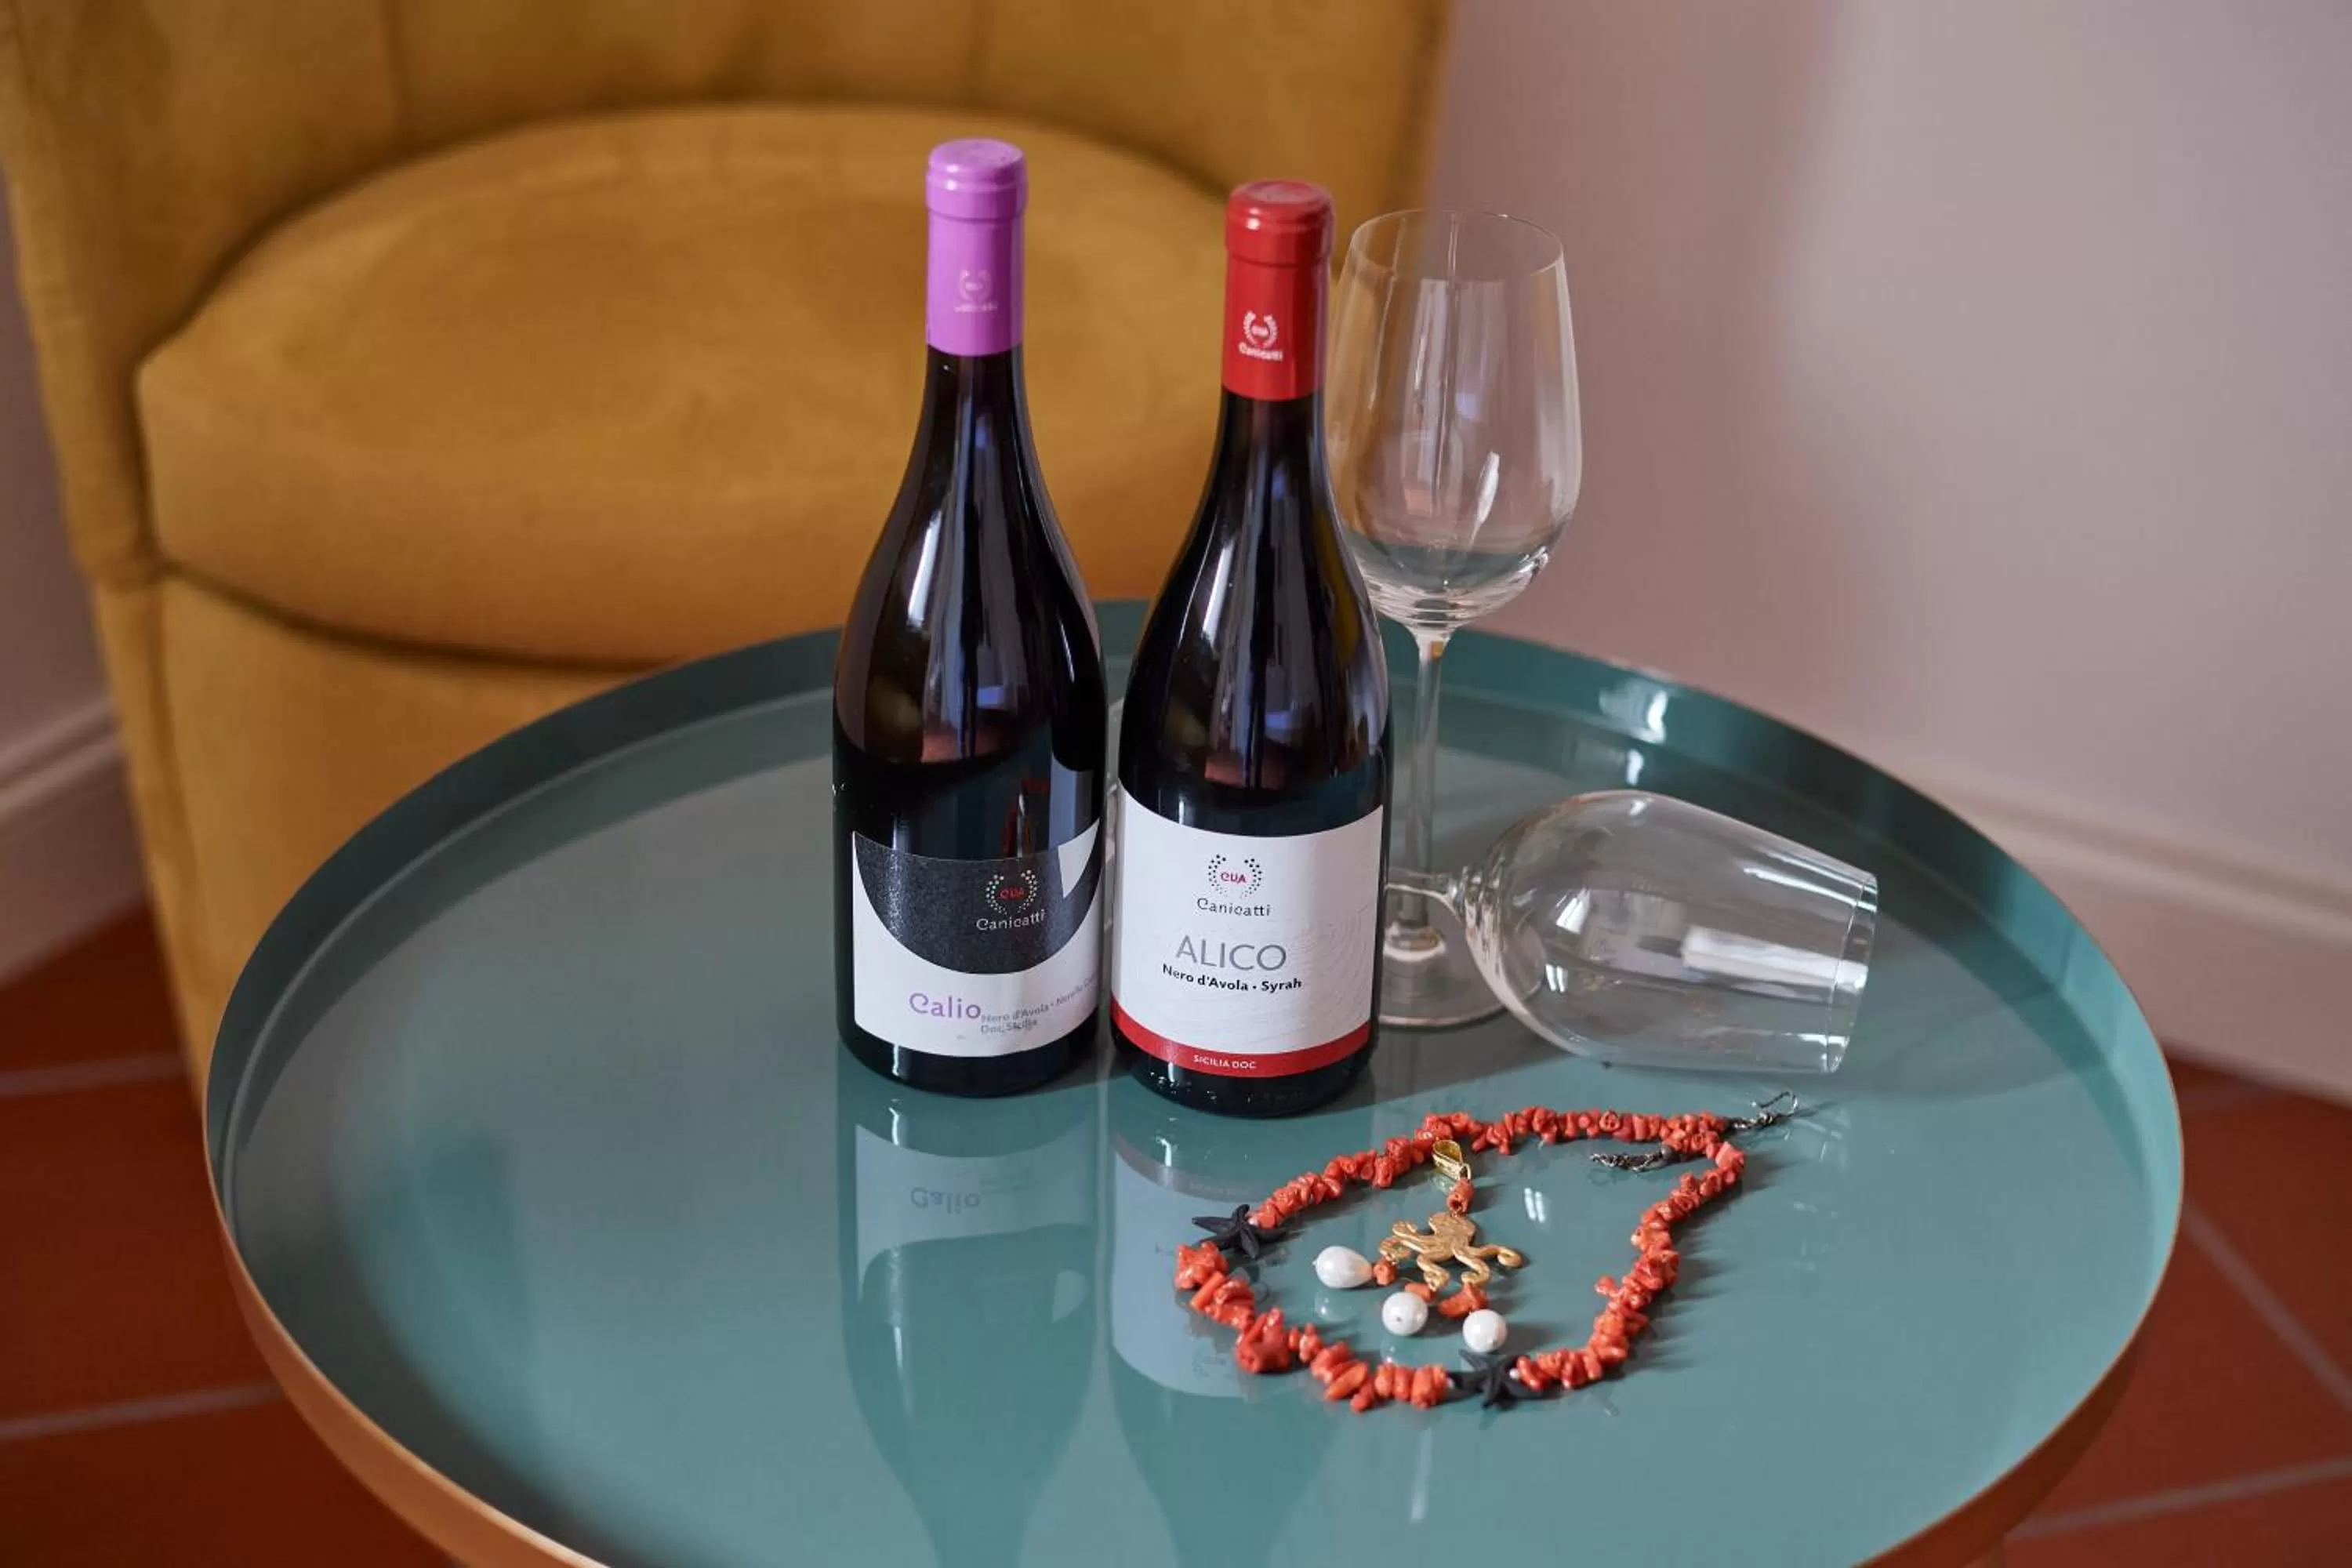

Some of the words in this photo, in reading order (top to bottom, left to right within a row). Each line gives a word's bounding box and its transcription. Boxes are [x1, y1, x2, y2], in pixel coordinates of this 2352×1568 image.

[1176, 935, 1287, 971] ALICO
[1162, 963, 1194, 982] Nero
[1197, 975, 1249, 992] d'Avola
[1261, 978, 1302, 994] Syrah
[909, 992, 982, 1019] Calio
[1193, 1054, 1230, 1067] SICILIA
[1232, 1061, 1258, 1069] DOC
